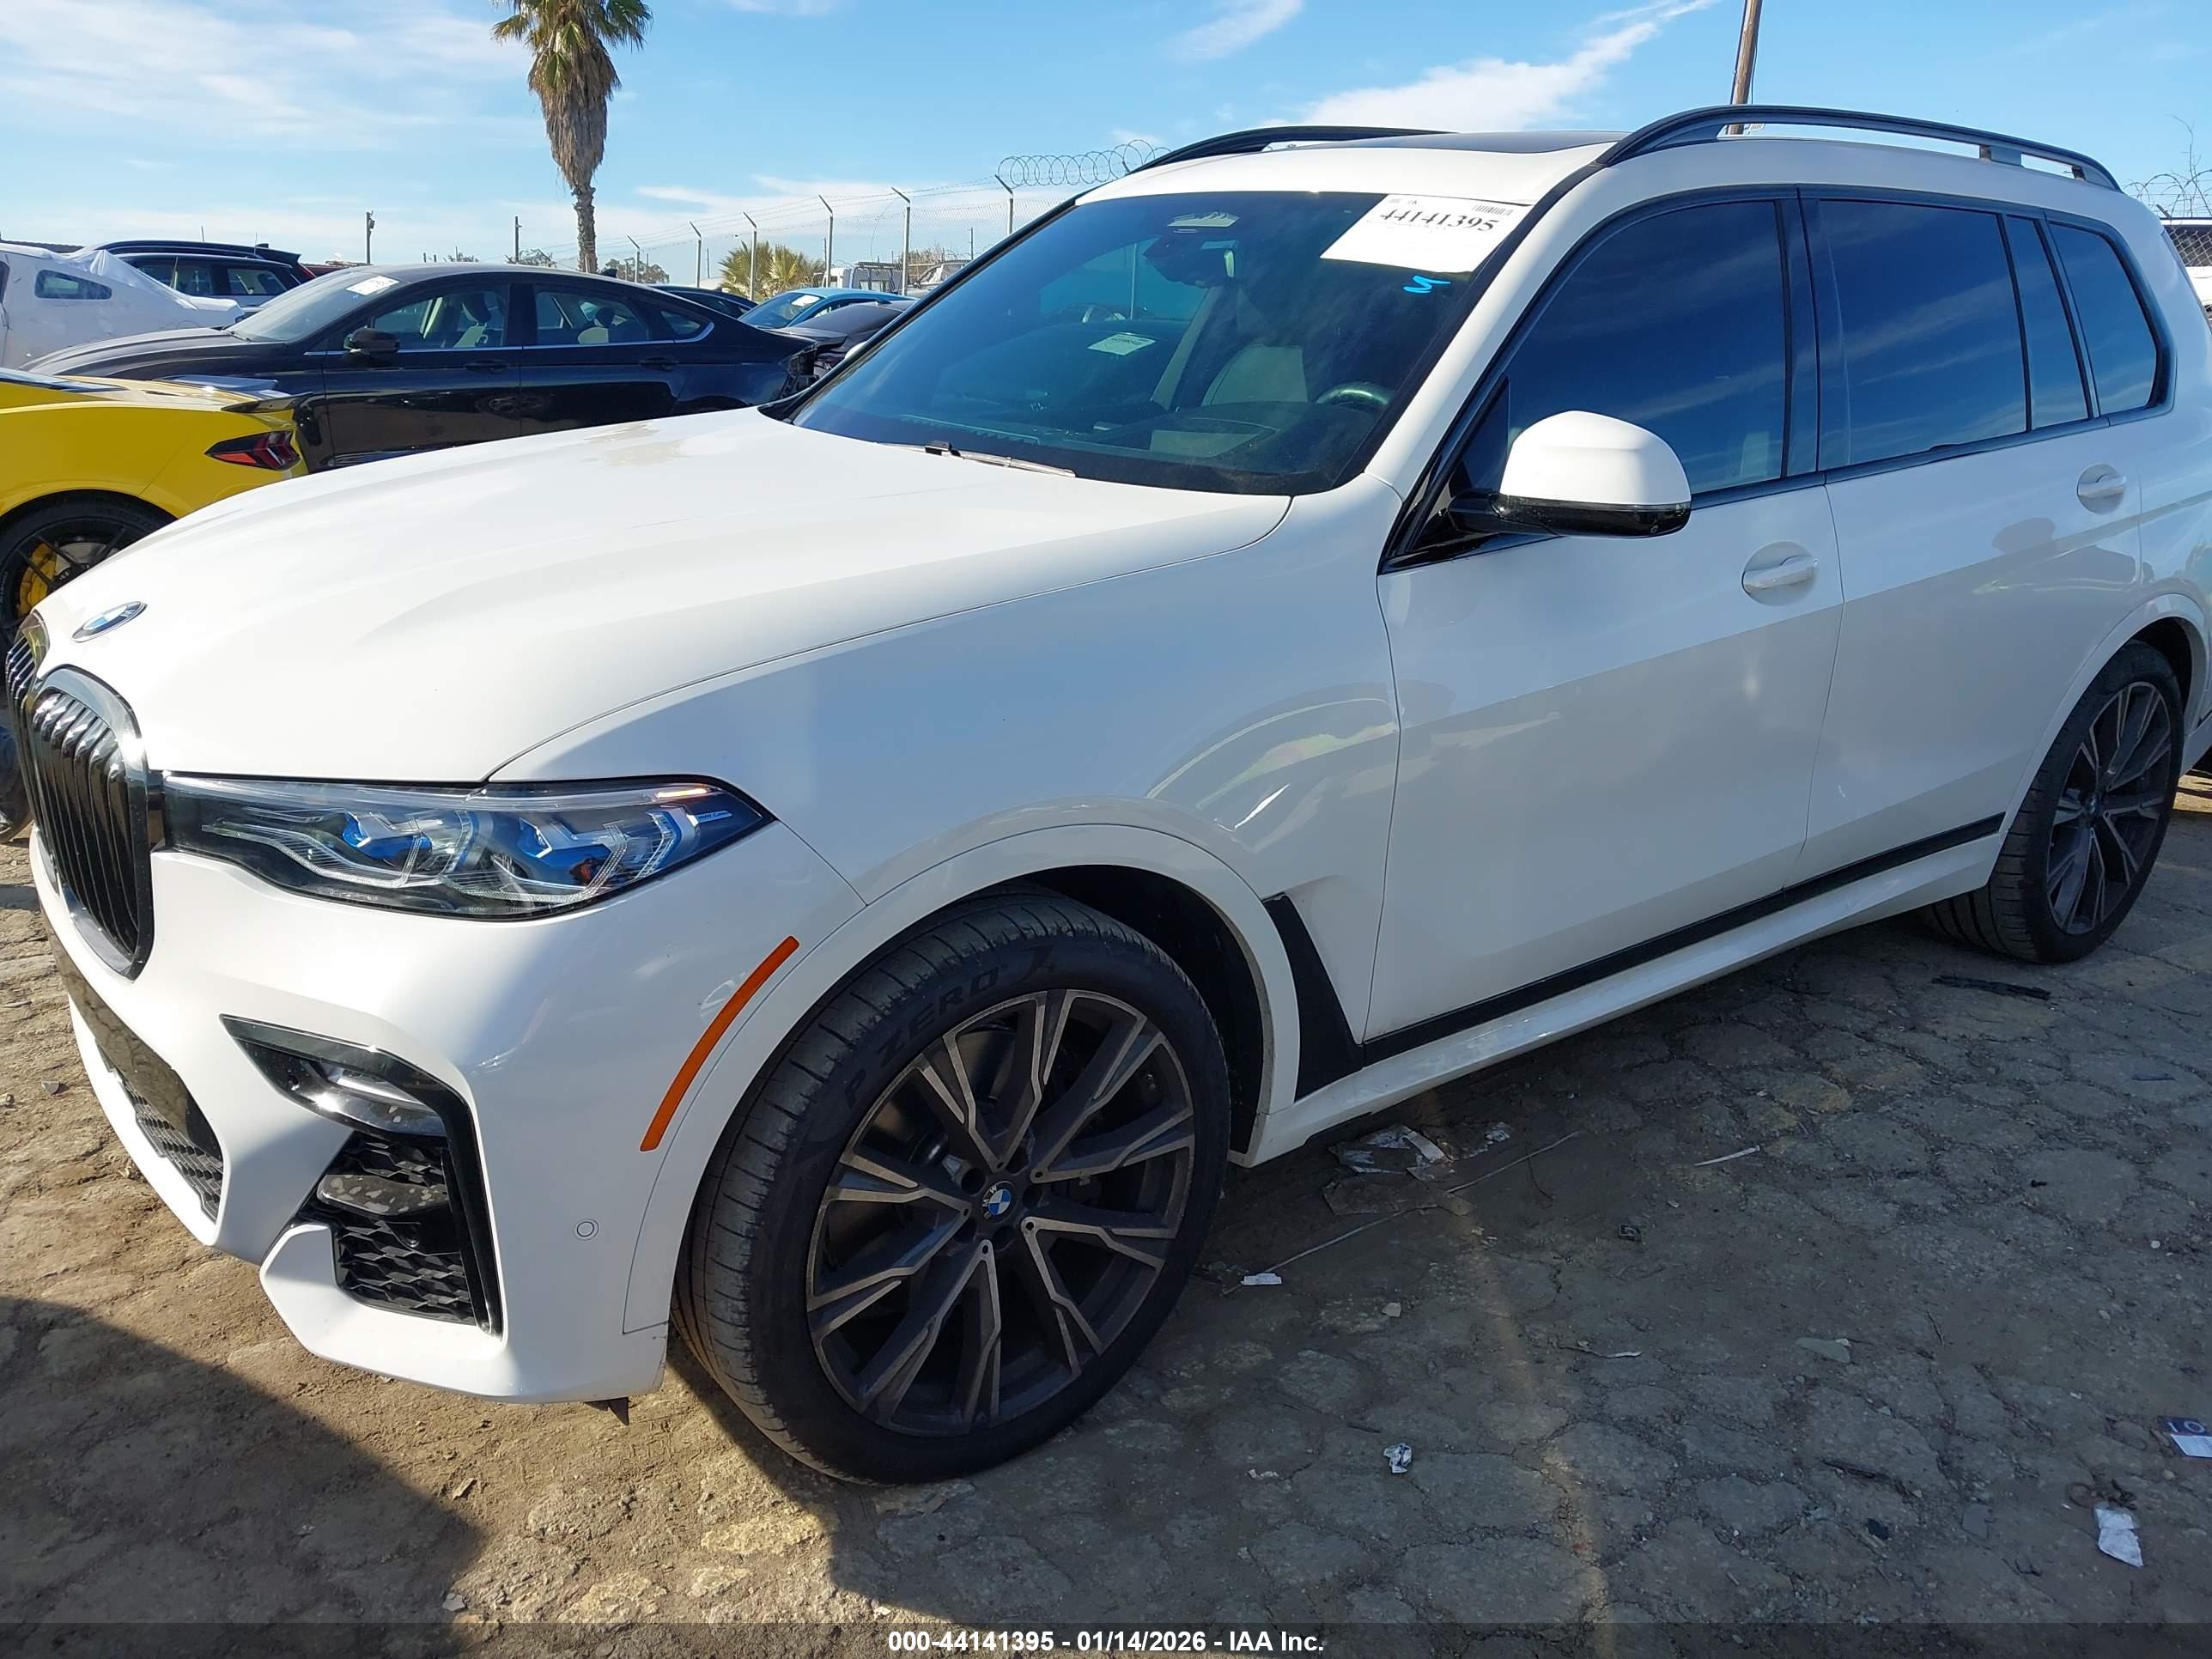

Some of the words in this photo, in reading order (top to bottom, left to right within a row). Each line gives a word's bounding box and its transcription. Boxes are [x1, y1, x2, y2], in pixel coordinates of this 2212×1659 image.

[1380, 208, 1500, 232] 44141395
[878, 967, 1000, 1067] ZERO
[981, 1184, 997, 1219] BMW
